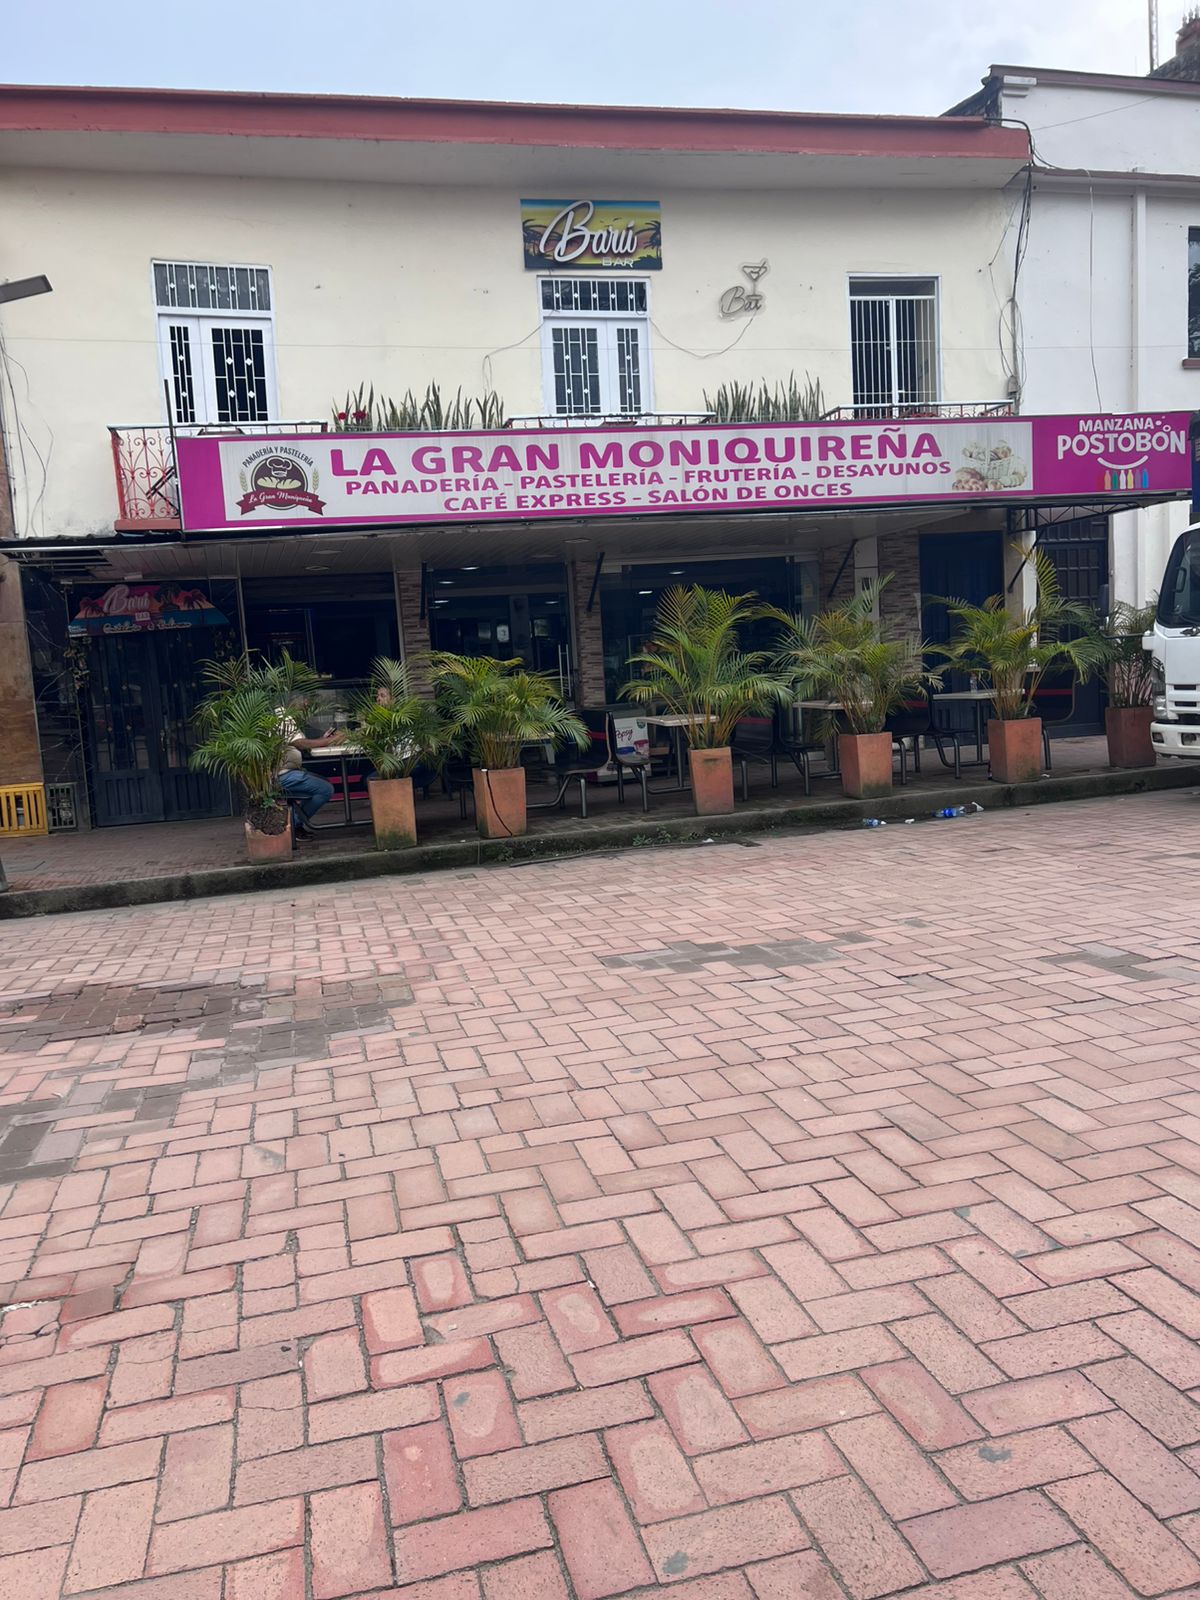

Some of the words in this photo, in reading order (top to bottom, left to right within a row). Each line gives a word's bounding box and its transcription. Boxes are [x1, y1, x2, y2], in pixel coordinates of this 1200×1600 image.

[539, 200, 638, 263] Barú
[602, 257, 635, 268] BAR
[720, 286, 763, 315] Bar
[1078, 418, 1155, 433] MANZANA
[242, 446, 273, 468] PANADERÍA
[279, 446, 314, 467] PASTELERÍA
[330, 449, 396, 477] LA
[412, 445, 560, 475] GRAN
[579, 427, 941, 470] MONIQUIREÑA
[346, 475, 499, 495] PANADERÍA
[521, 468, 664, 491] PASTELERÍA
[684, 464, 796, 484] FRUTERÍA
[817, 462, 950, 478] DESAYUNOS
[259, 492, 276, 503] Gran
[445, 493, 507, 512] CAFÉ
[517, 491, 626, 509] EXPRESS
[648, 485, 728, 504] SALÓN
[737, 487, 766, 500] DE
[775, 483, 852, 499] ONCES
